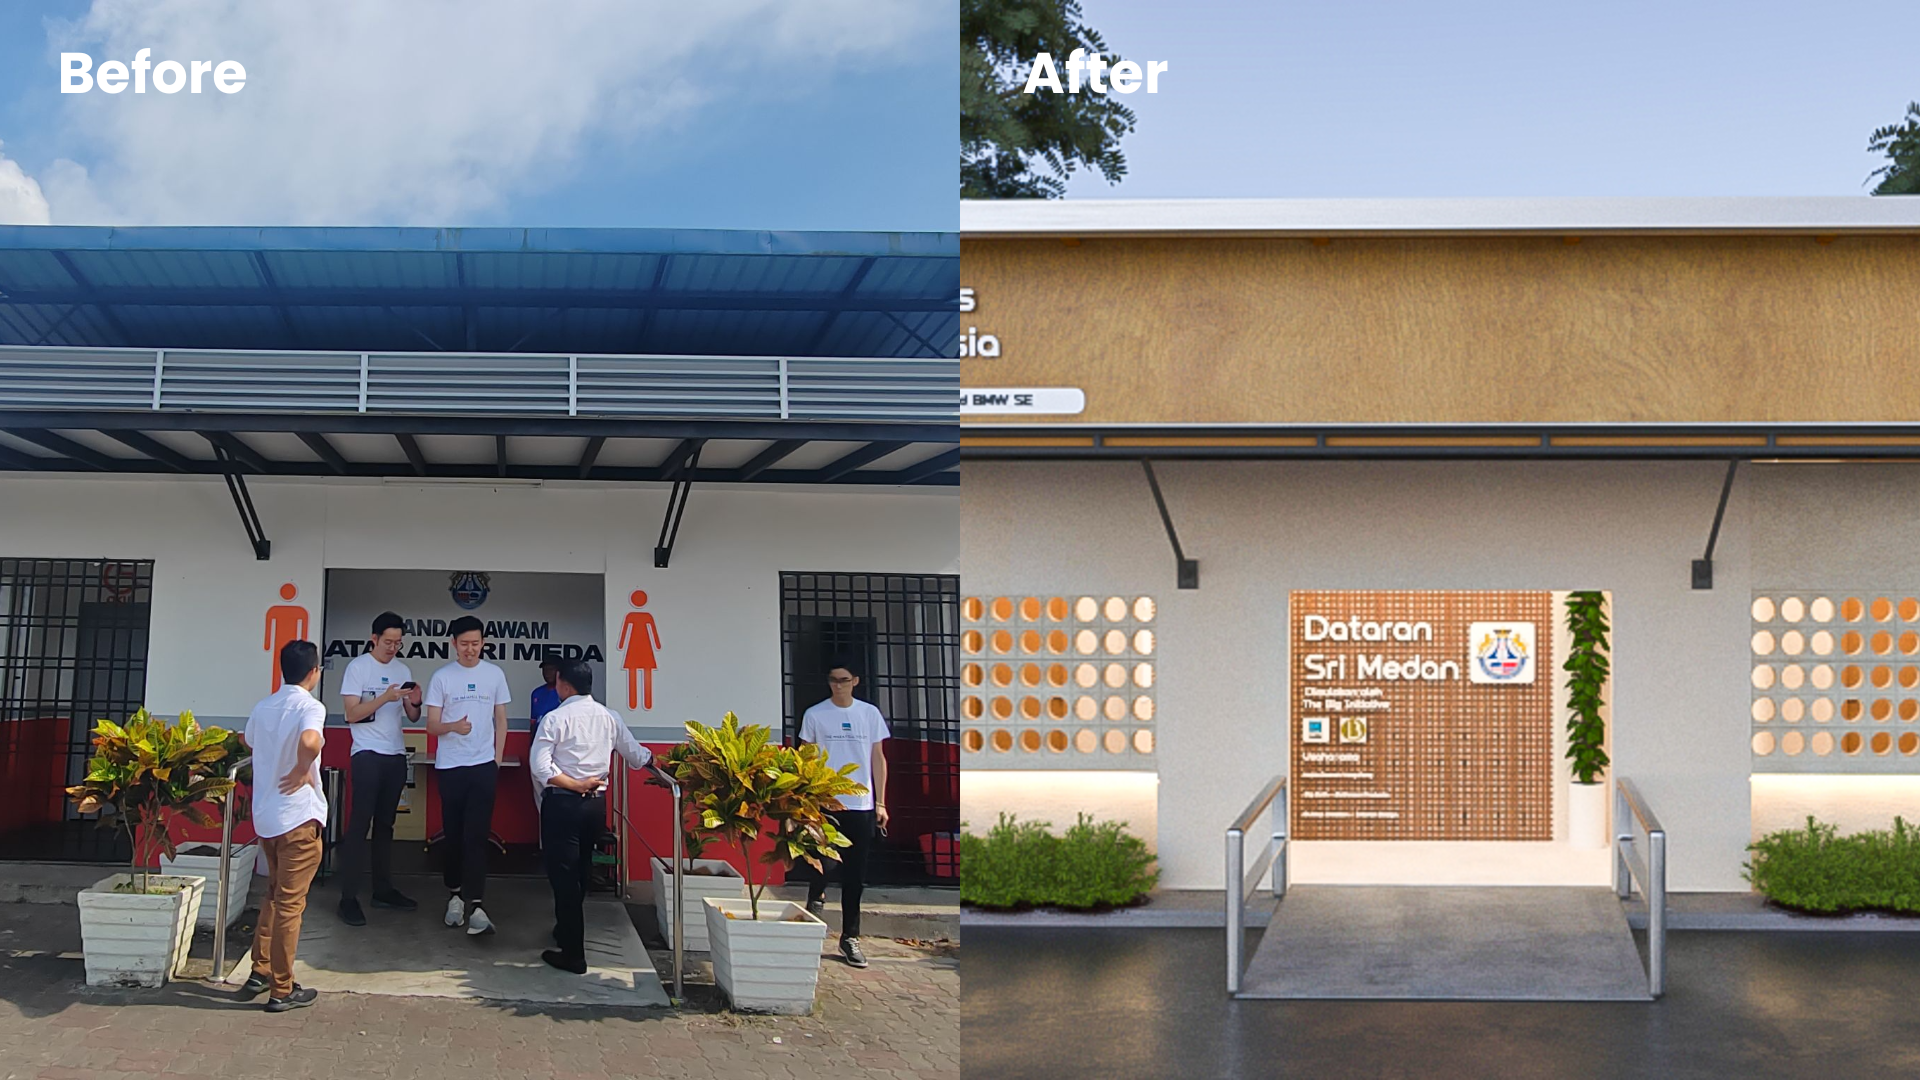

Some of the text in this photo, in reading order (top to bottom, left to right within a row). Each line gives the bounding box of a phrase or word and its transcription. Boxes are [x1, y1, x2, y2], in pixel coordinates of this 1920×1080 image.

[484, 620, 549, 640] AWAM
[1304, 614, 1433, 641] Dataran
[1304, 653, 1460, 681] Sri Medan
